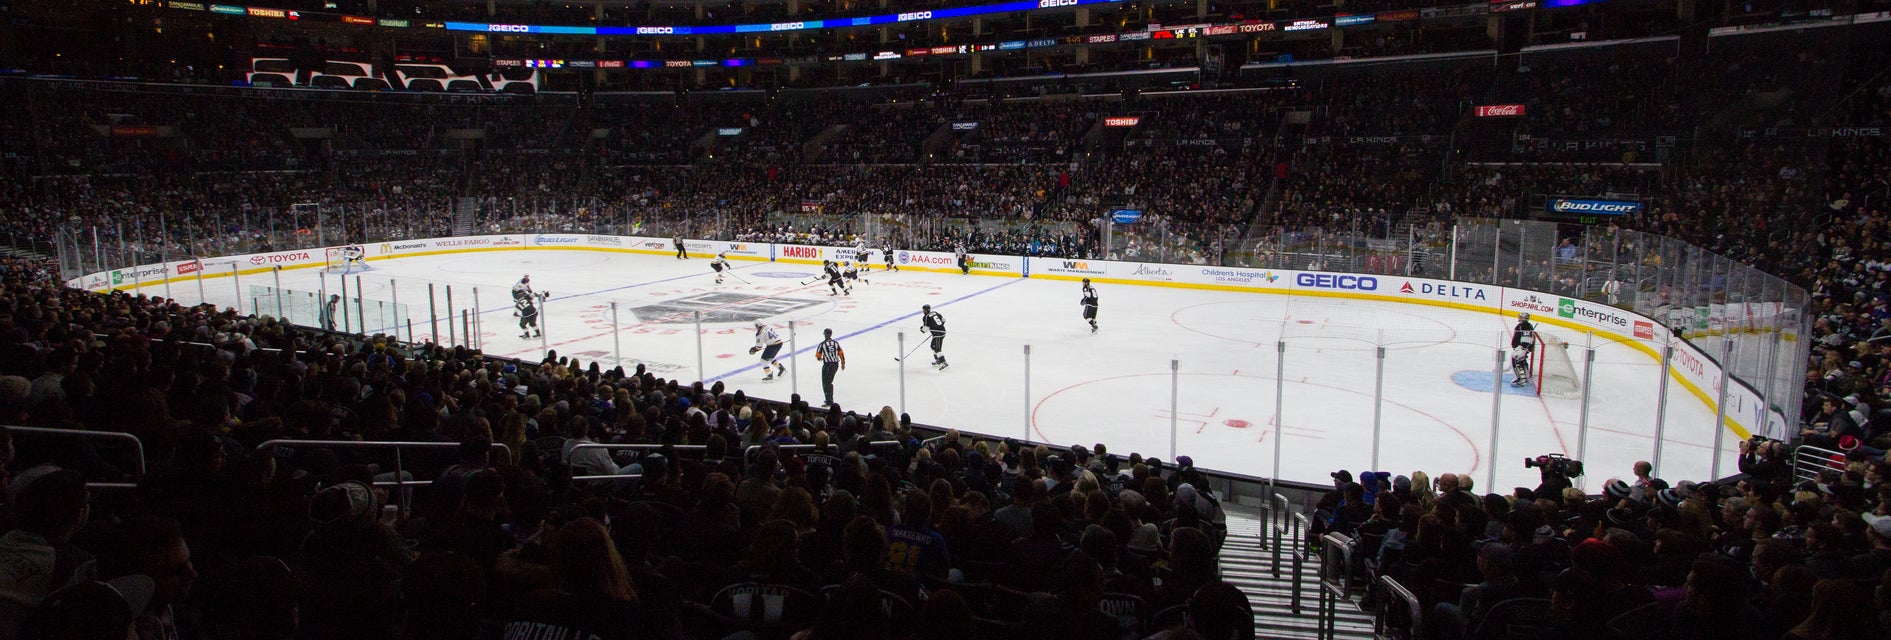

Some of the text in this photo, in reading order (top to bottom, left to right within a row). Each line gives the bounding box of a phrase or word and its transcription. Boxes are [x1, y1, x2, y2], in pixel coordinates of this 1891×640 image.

[1040, 0, 1077, 8] GEICO
[248, 8, 285, 17] TOSHIBA
[901, 11, 932, 21] GEICO
[492, 24, 529, 32] GEICO
[774, 22, 805, 30] GEICO
[1240, 23, 1275, 32] TOYOTA
[1033, 39, 1056, 47] DELTA
[1089, 35, 1115, 43] STAPLES
[931, 45, 957, 54] TOSHIBA
[1488, 105, 1519, 116] Coca-Cola
[1105, 118, 1138, 126] TOSHIBA
[1832, 127, 1880, 137] KINGS
[1560, 201, 1636, 212] BUD LIGHT
[1580, 216, 1597, 224] EXIT
[394, 242, 426, 250] McDonald's
[435, 240, 463, 248] WELLS
[645, 241, 664, 249] verizon
[268, 252, 310, 263] TOYOTA
[783, 246, 817, 259] HARIBO
[911, 254, 952, 265] AAA.com
[1063, 261, 1089, 270] WM
[1132, 263, 1173, 276] Alberta
[1202, 269, 1266, 280] Children's Hospital
[1297, 273, 1378, 291] GEICO
[1422, 283, 1486, 301] DELTA
[517, 298, 530, 311] 12
[1511, 300, 1554, 313] SHOP.NHL.COM
[1563, 303, 1627, 327] enterprise
[1680, 347, 1705, 379] TOYOTA
[807, 455, 832, 465] TOFFOLI
[892, 529, 932, 545] TARASENKO
